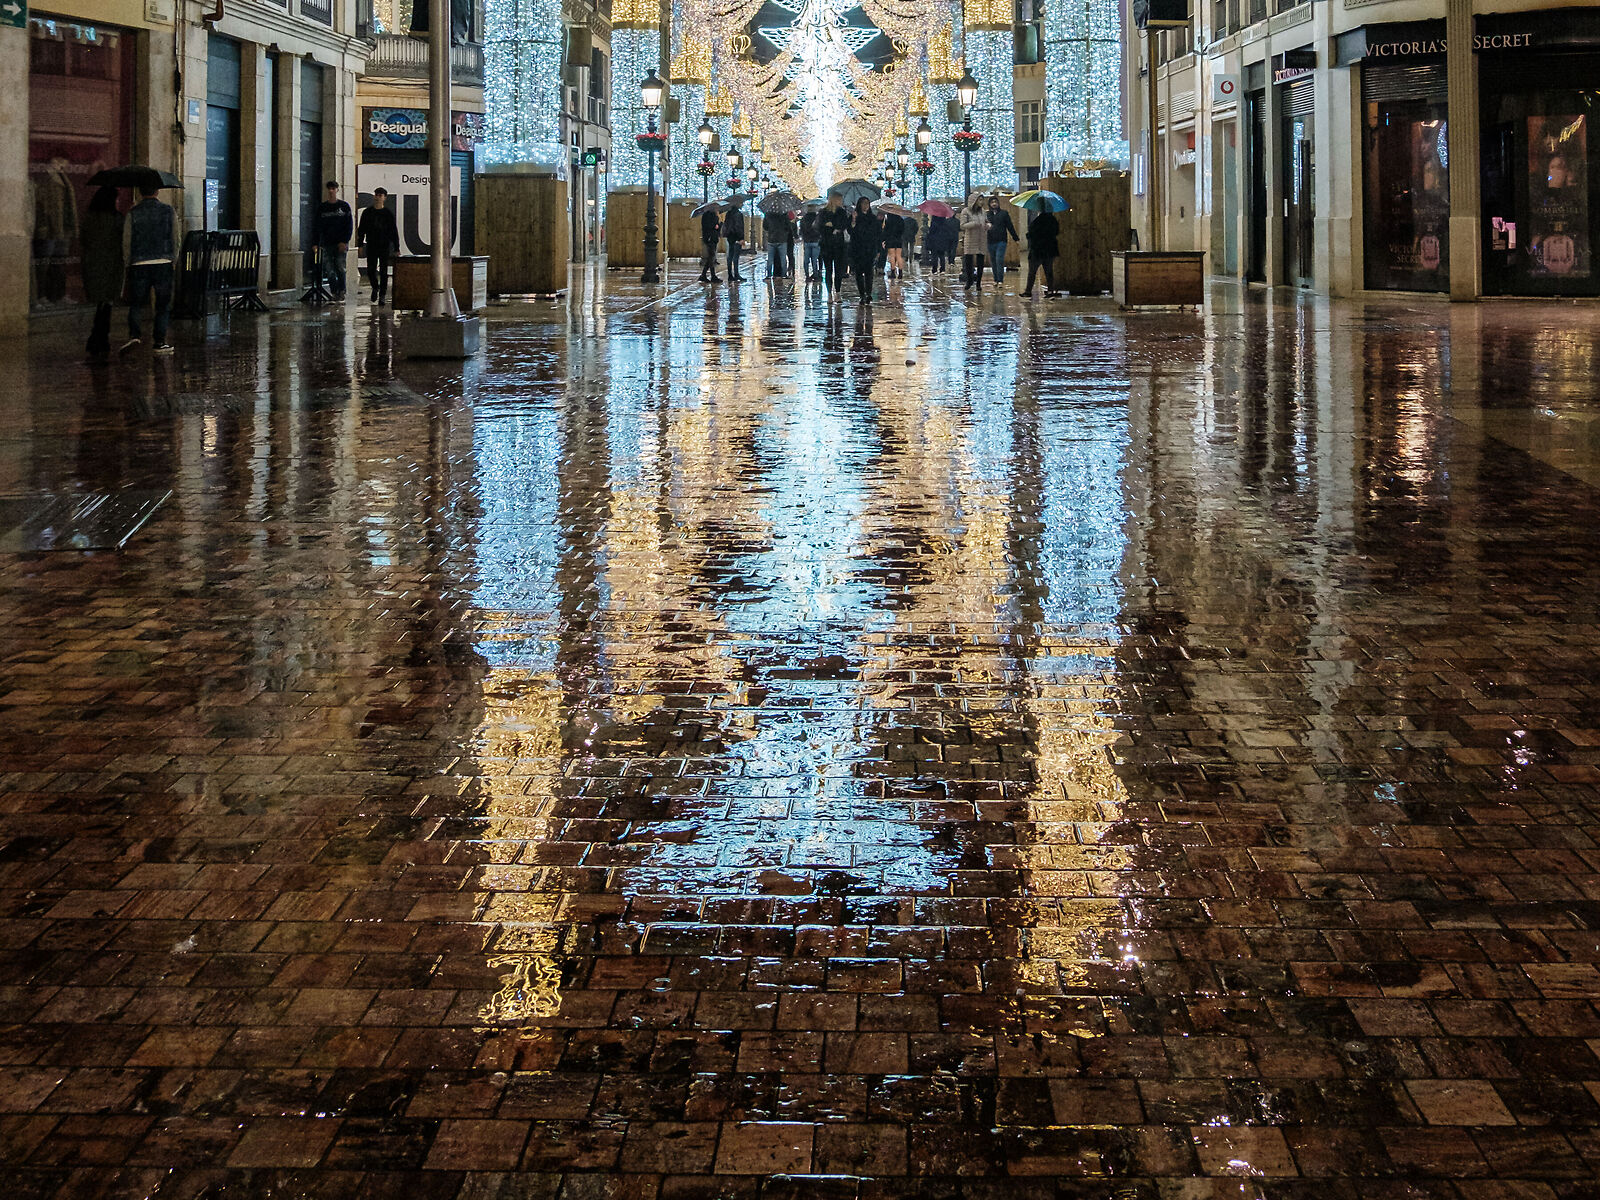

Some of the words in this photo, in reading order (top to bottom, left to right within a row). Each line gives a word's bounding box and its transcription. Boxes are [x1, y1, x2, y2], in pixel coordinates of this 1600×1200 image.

[1366, 39, 1448, 57] VICTORIA'S
[1473, 33, 1532, 49] SECRET
[370, 120, 427, 136] Desigual
[455, 123, 485, 139] Desigua
[402, 174, 431, 186] Desig
